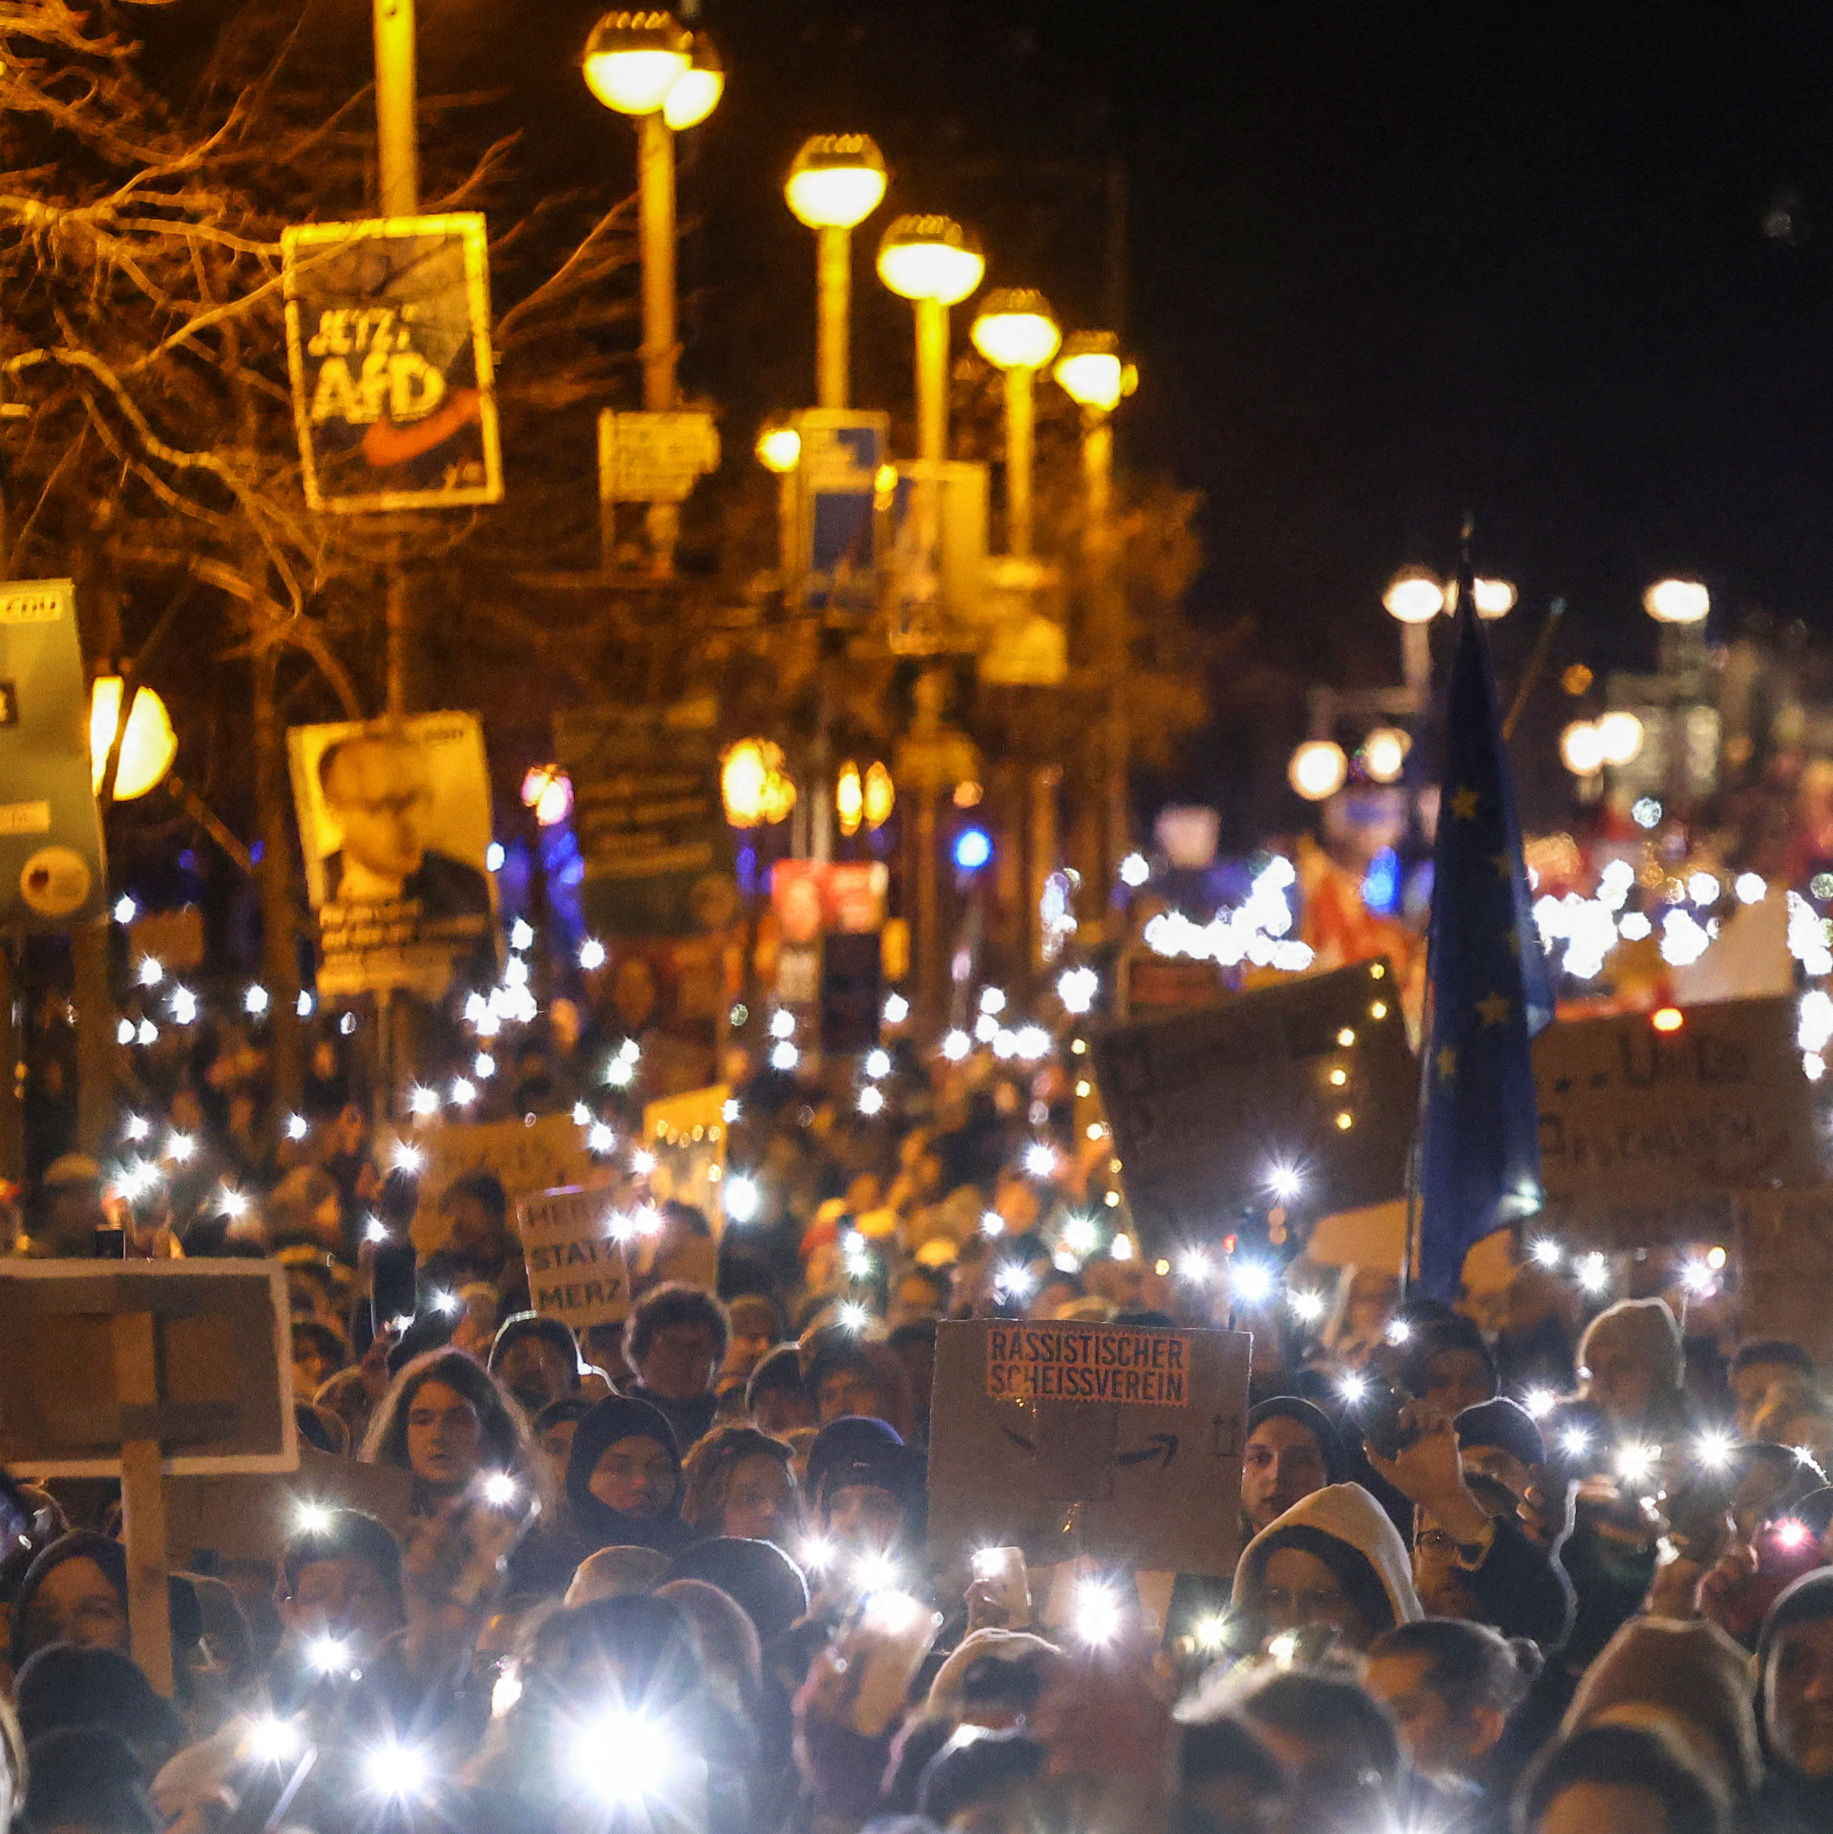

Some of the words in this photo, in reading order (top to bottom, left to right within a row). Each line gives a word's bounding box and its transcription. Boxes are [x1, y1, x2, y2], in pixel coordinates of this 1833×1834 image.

[310, 352, 446, 425] AfD
[537, 1277, 623, 1312] MERZ
[990, 1330, 1184, 1370] RASSISTISCHER
[990, 1364, 1183, 1402] SCHEISSVEREIN
